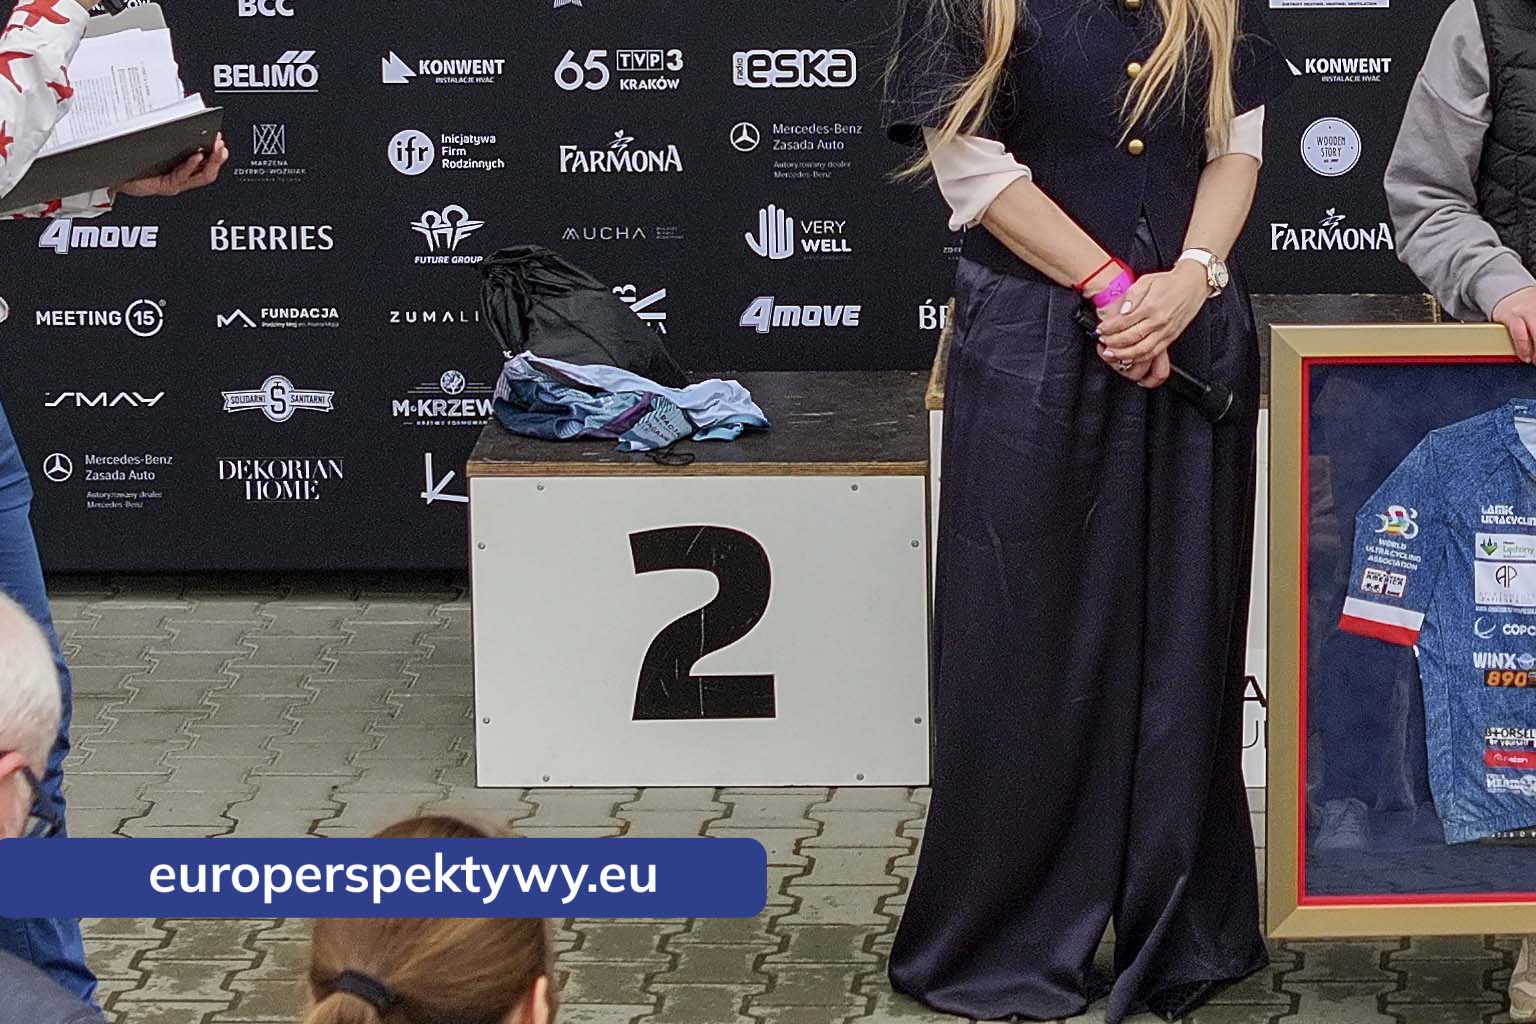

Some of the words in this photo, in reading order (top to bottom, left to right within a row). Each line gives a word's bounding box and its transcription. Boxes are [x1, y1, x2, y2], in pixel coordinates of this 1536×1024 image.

[419, 59, 506, 75] KONWENT
[618, 51, 661, 69] TVP
[666, 48, 684, 71] 3
[554, 49, 610, 91] 65
[619, 75, 680, 91] KRAKÓW
[772, 123, 862, 135] Mercedes-Benz
[441, 133, 497, 149] Inicjatywa
[772, 139, 814, 151] Zasada
[817, 139, 845, 150] Auto
[1316, 136, 1346, 146] WOODEN
[441, 145, 467, 157] Firm
[1321, 147, 1343, 158] STORY
[441, 158, 505, 171] Rodzinnych
[559, 145, 683, 173] FARMONA
[800, 220, 846, 234] VERY
[1271, 223, 1393, 250] FARMONA
[800, 238, 852, 253] WELL
[414, 255, 450, 264] FUTURE
[450, 255, 484, 264] GROUP
[35, 310, 122, 326] MEETING
[130, 306, 159, 330] 15
[628, 525, 777, 721] 2
[1487, 671, 1527, 686] 890
